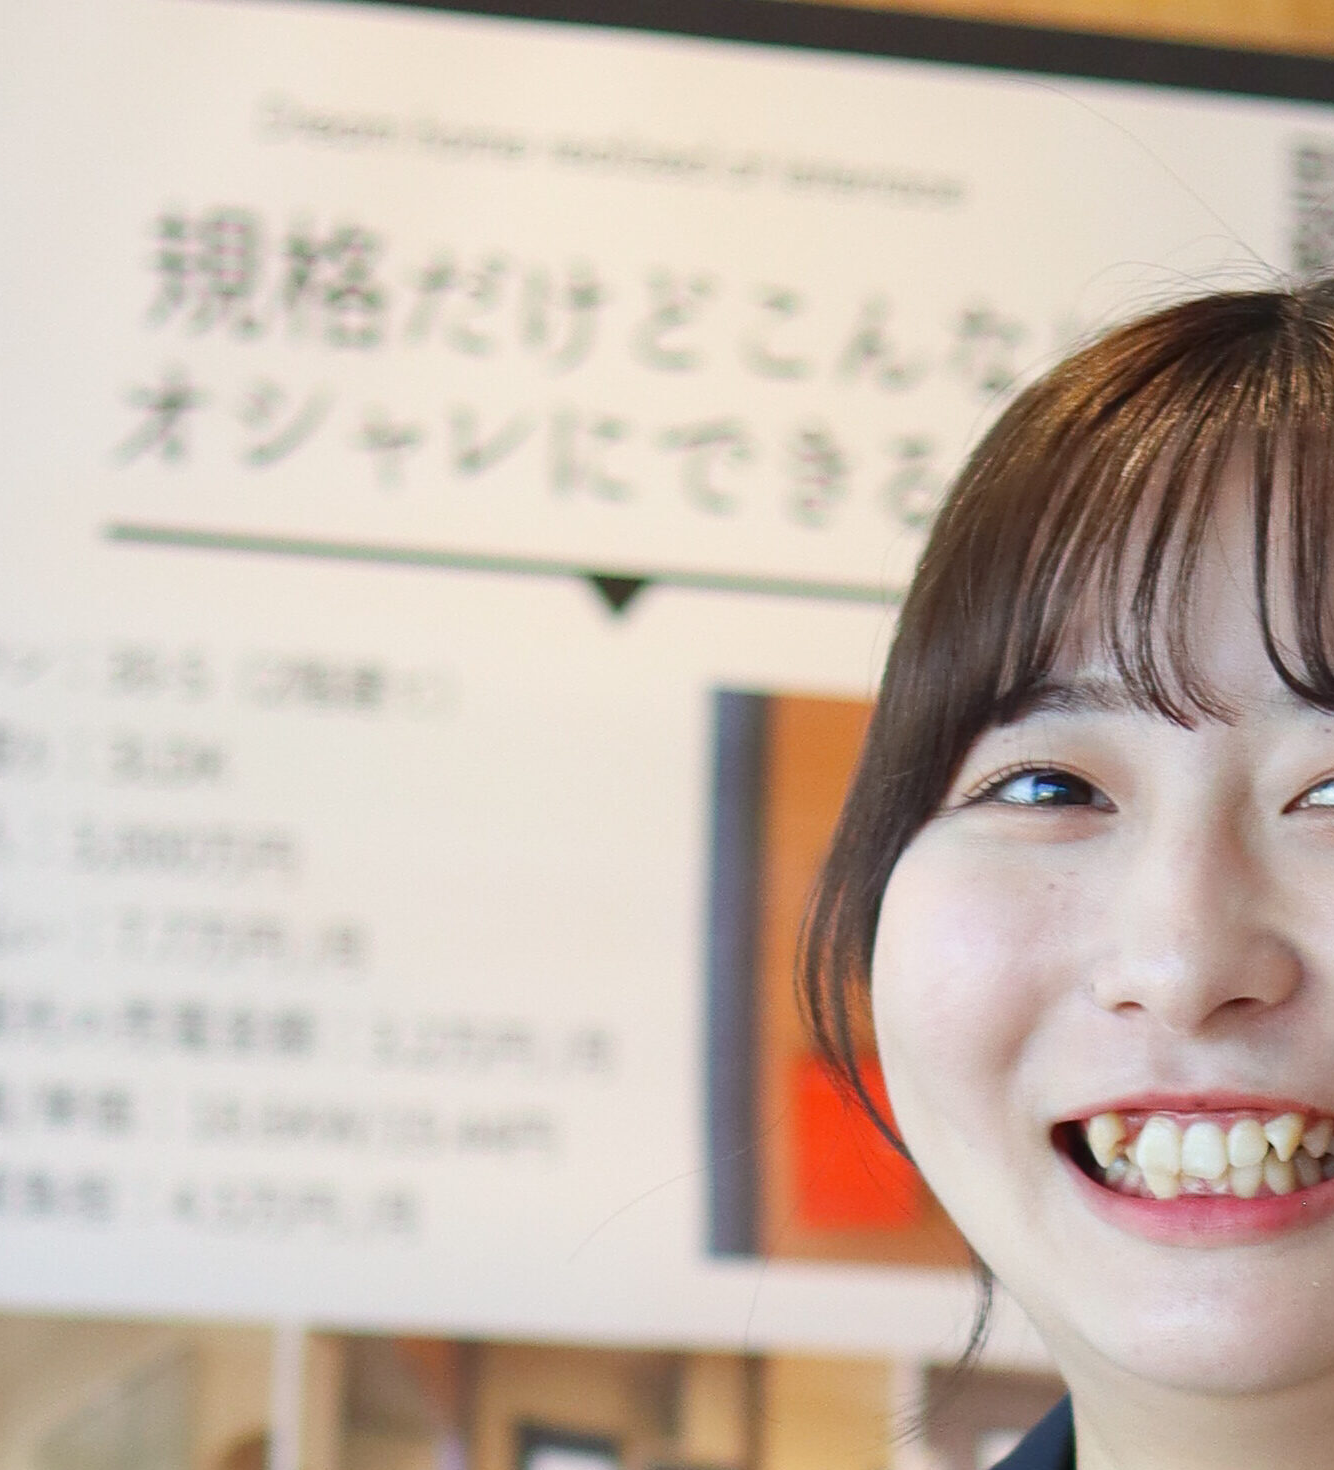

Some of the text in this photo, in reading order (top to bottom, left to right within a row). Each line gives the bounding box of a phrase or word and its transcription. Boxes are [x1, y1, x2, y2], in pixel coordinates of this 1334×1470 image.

[143, 206, 1079, 398] 規格だけどこんな
